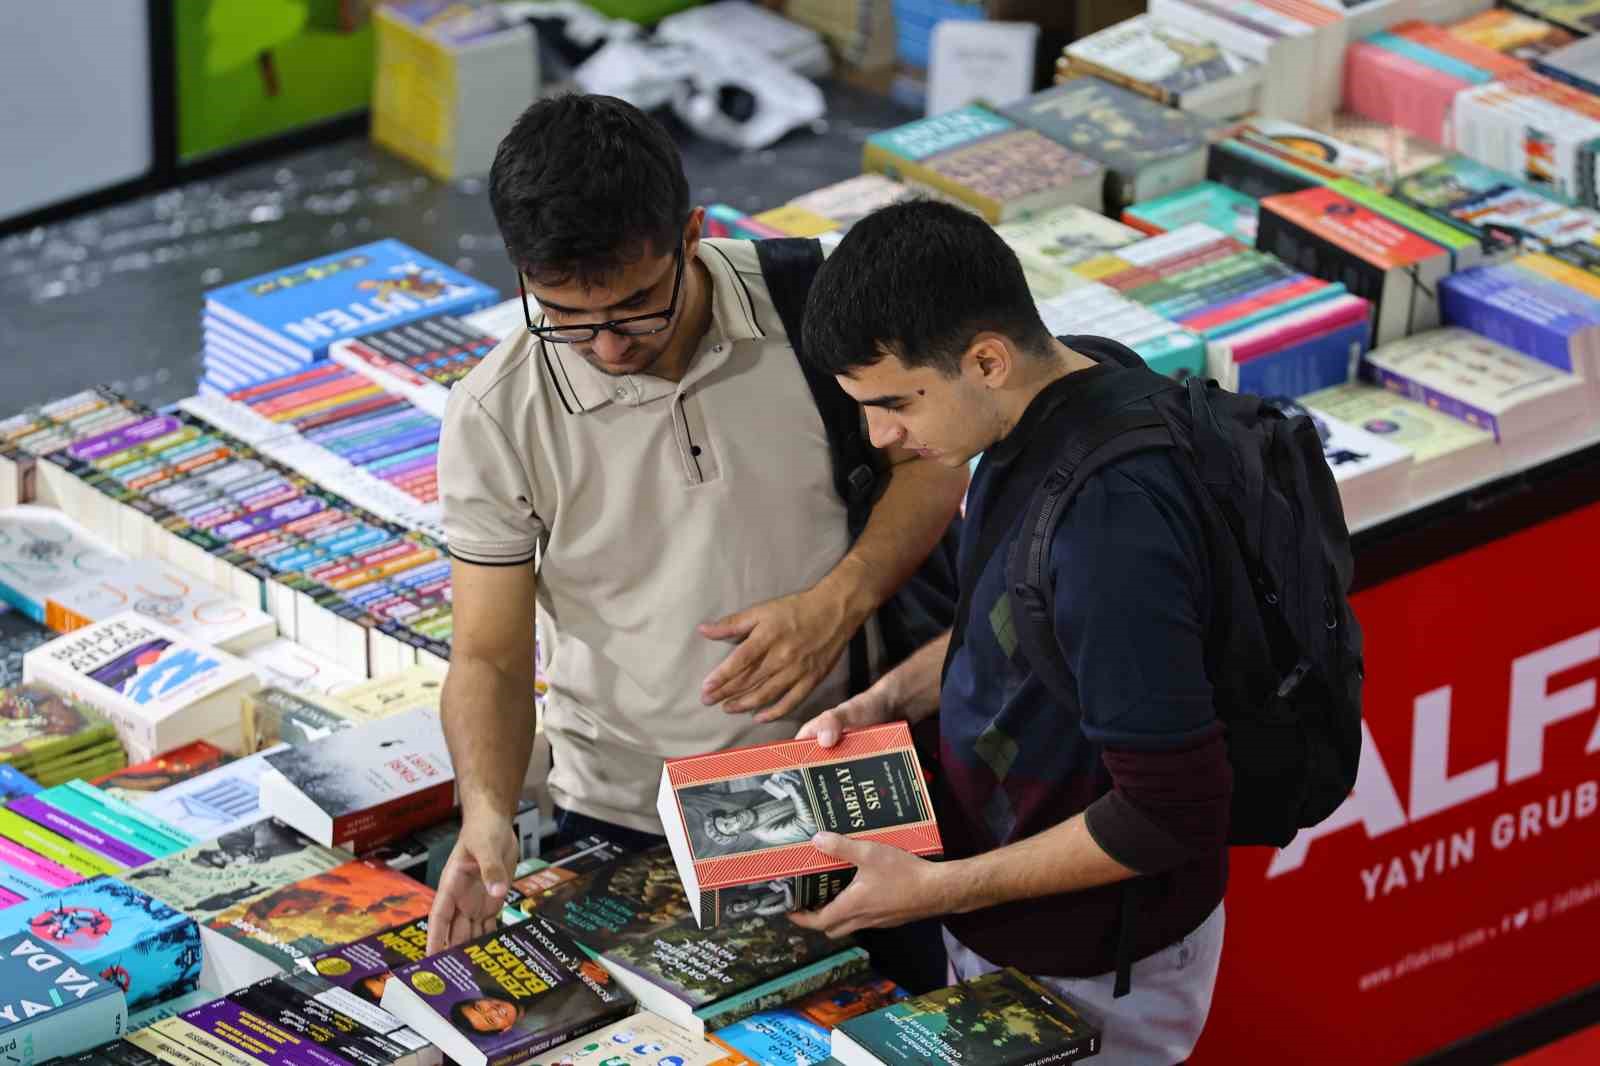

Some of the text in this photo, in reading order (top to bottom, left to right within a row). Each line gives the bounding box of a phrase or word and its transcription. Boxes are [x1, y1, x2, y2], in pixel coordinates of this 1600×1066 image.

[1267, 627, 1600, 881] ALF
[835, 767, 865, 828] SABETAY
[859, 779, 881, 811] SEVİ
[1361, 779, 1598, 901] YAYIN GRUB
[10, 939, 99, 999] YA DA
[483, 938, 550, 995] BABA
[499, 933, 527, 959] BABA
[525, 923, 571, 967] KIYOSAKI
[464, 944, 531, 1000] ZENGİN
[523, 957, 557, 989] YOKSUL
[578, 970, 616, 1003] ROBERT
[894, 1031, 931, 1057] OSMANLI
